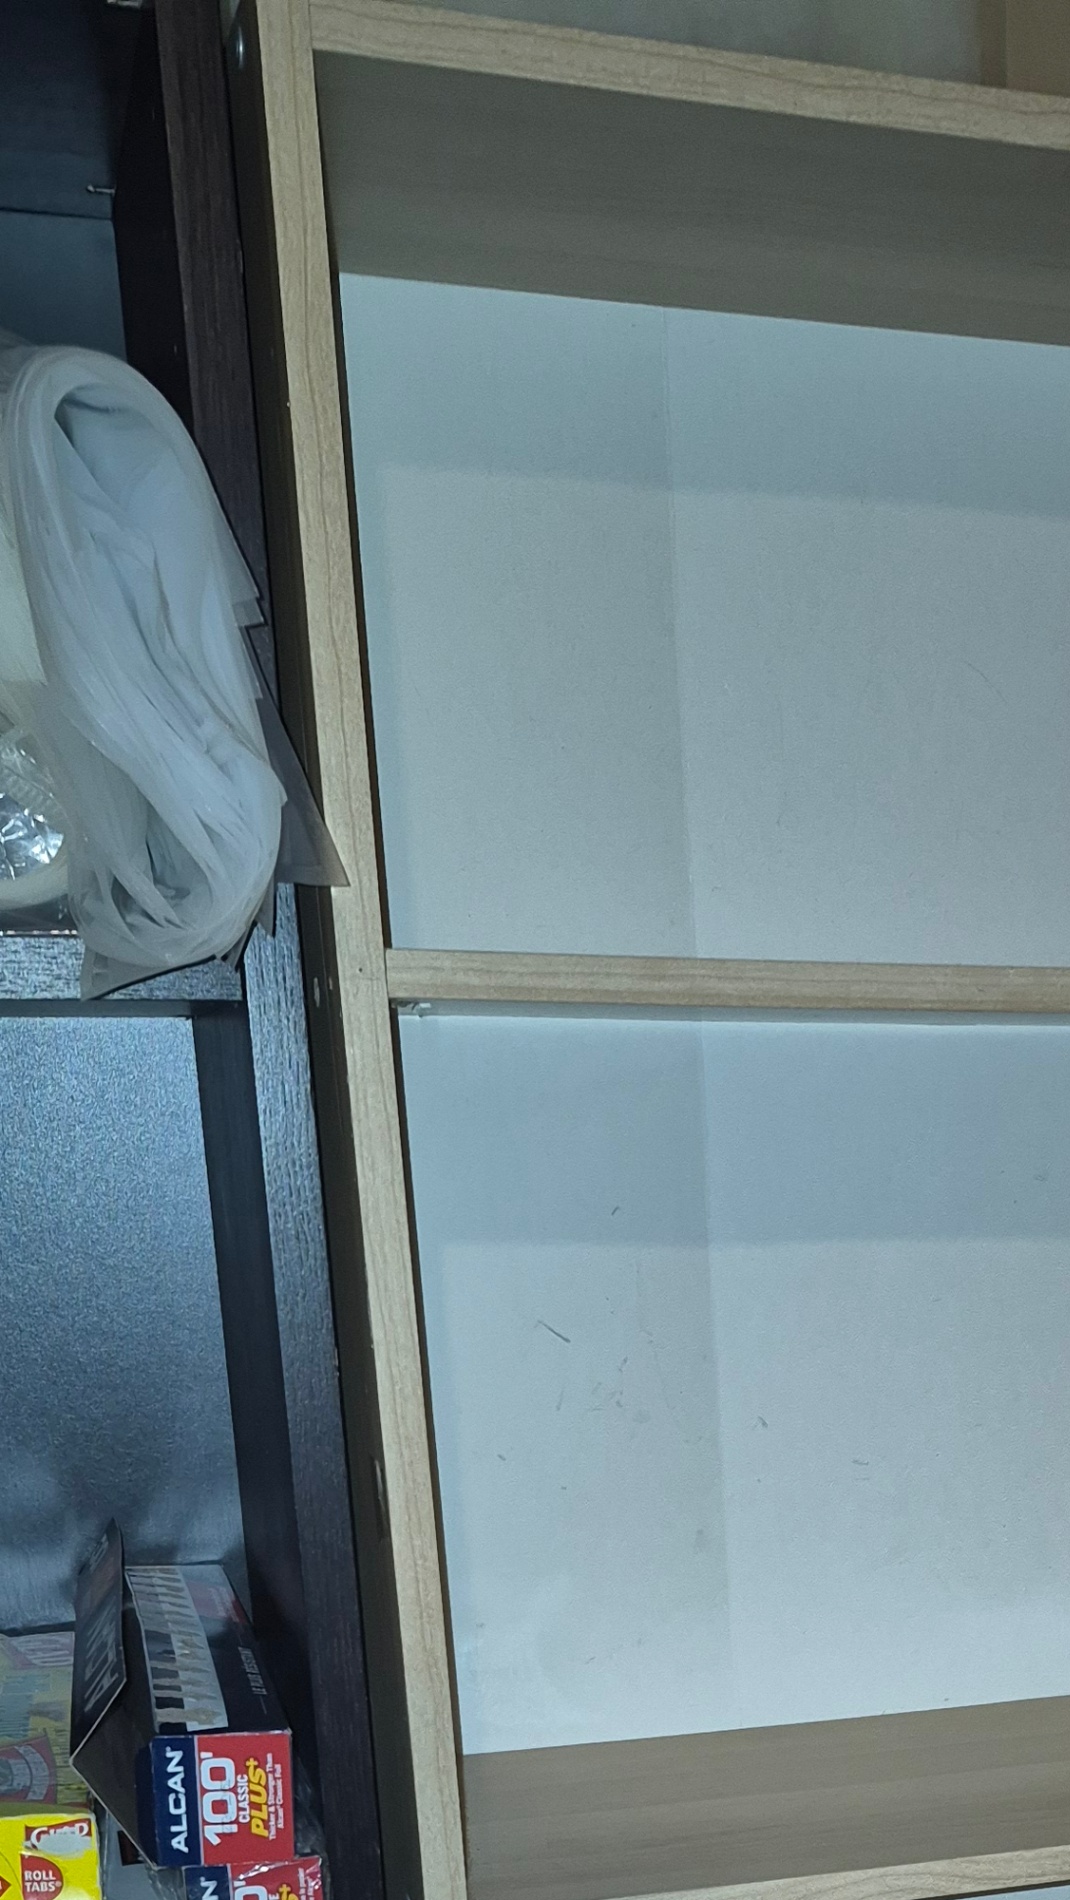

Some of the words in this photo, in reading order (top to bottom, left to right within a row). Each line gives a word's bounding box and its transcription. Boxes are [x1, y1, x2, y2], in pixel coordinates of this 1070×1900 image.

[167, 1748, 189, 1853] ALCAN
[237, 1774, 250, 1823] CLASSIC
[24, 1870, 56, 1881] ROLL
